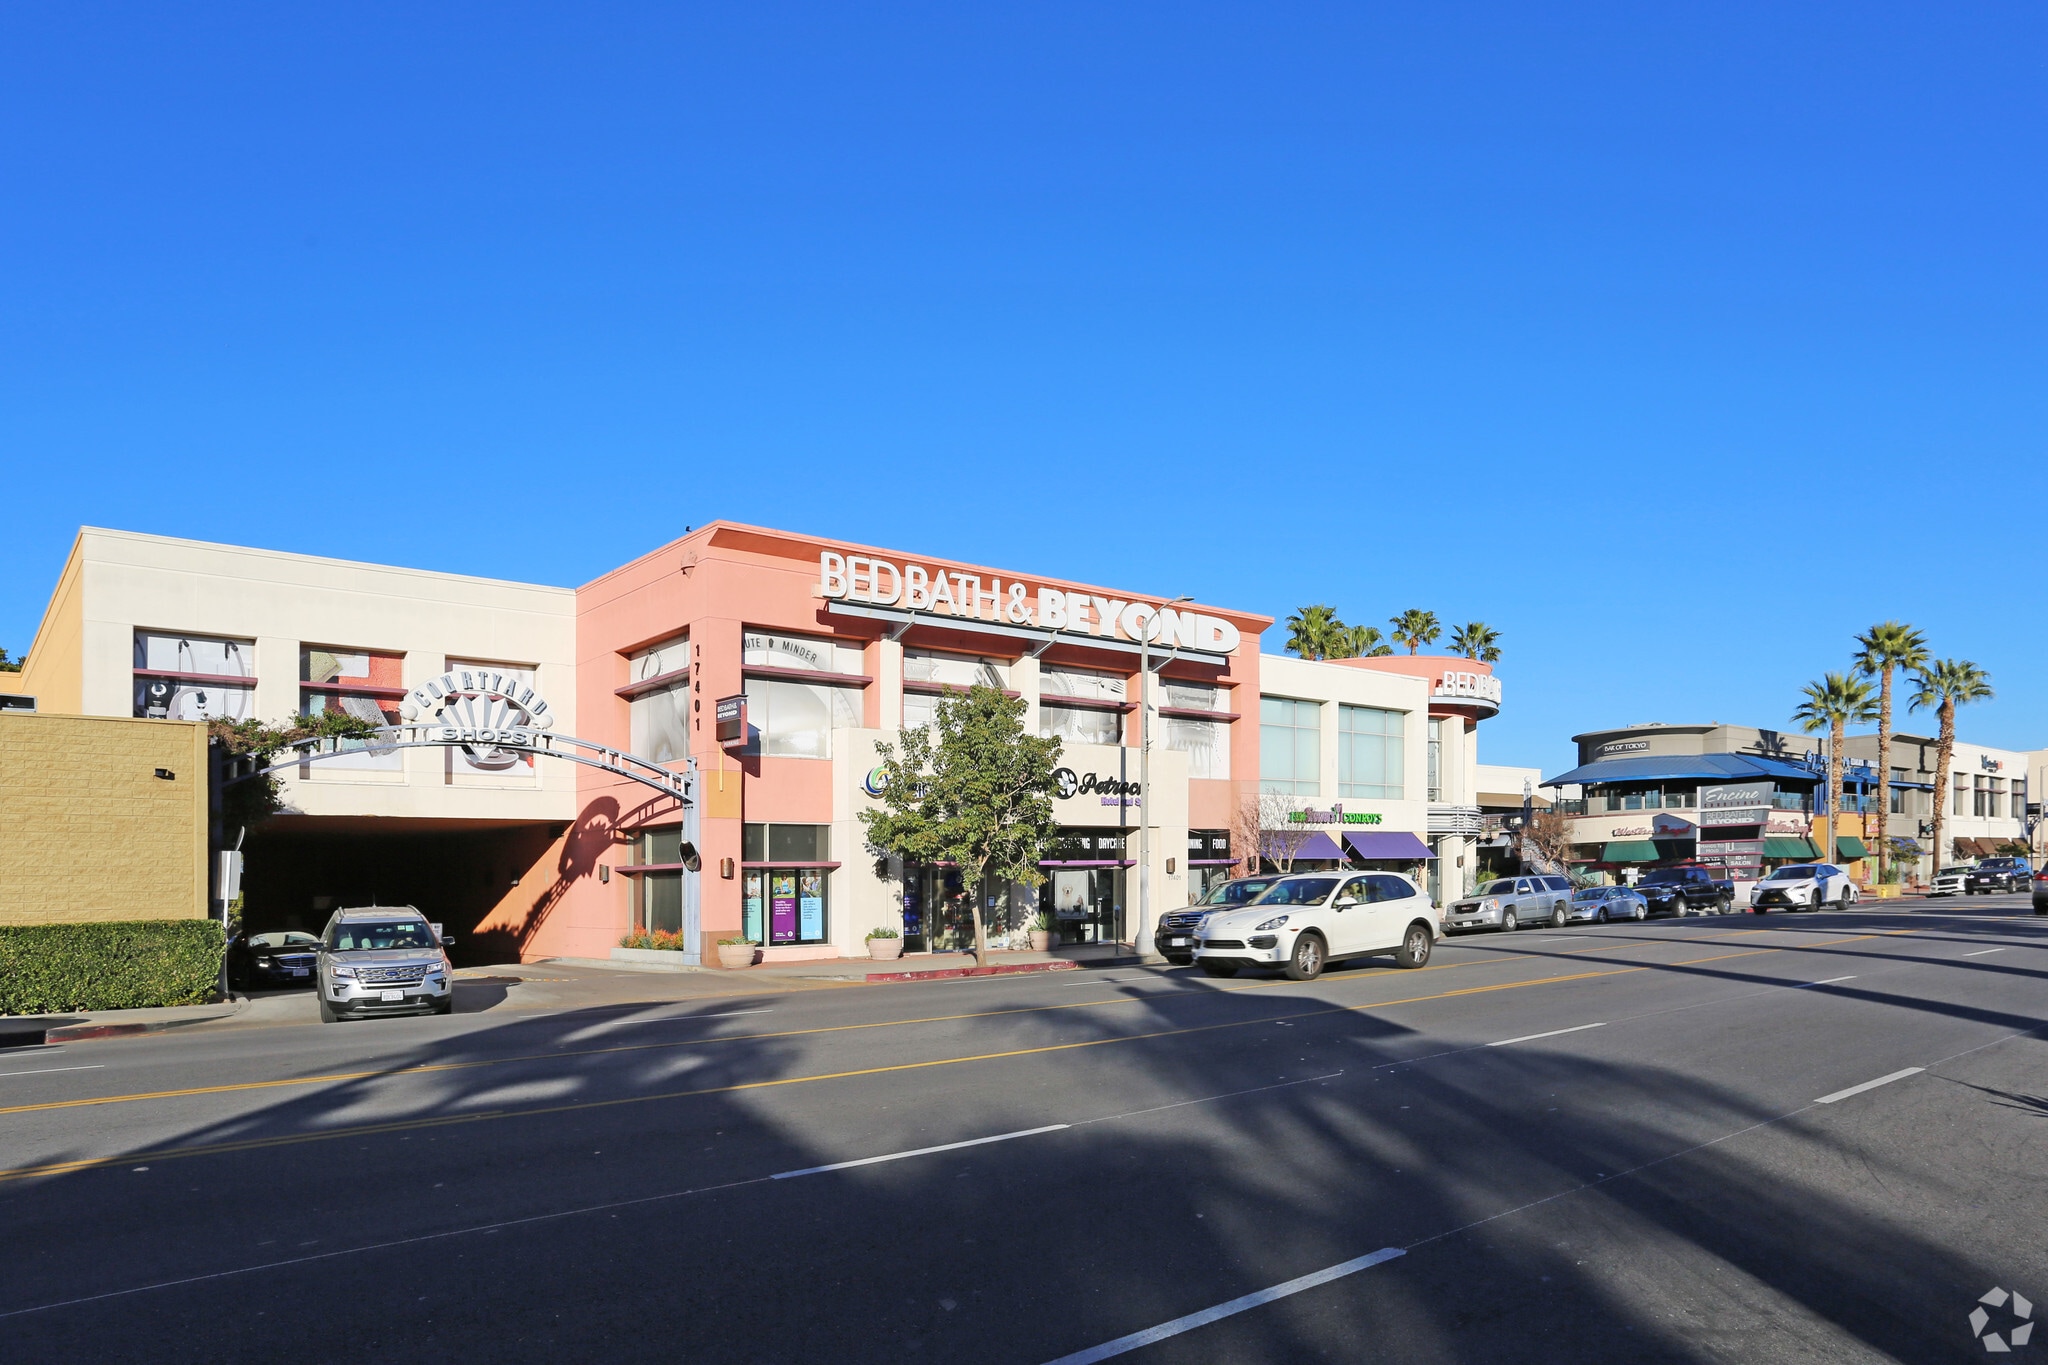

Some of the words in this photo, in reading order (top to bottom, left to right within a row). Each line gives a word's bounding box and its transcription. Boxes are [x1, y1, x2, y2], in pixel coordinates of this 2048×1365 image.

[820, 551, 901, 605] BED
[905, 564, 1000, 621] BATH
[1006, 582, 1033, 626] &
[1038, 587, 1241, 653] BEYOND
[782, 640, 818, 663] MINDER
[1442, 670, 1480, 698] BED
[412, 670, 549, 716] COURTYARD
[442, 728, 529, 746] SHOPS
[1604, 744, 1615, 752] BAR
[1625, 742, 1647, 750] TOKYO
[1100, 797, 1120, 807] Hotel
[1705, 787, 1760, 803] Encino
[1706, 811, 1723, 820] BED
[1724, 810, 1747, 819] BATH
[1706, 817, 1755, 825] BEYOND
[1098, 837, 1125, 850] DAYCARE
[1212, 838, 1227, 850] FOOD
